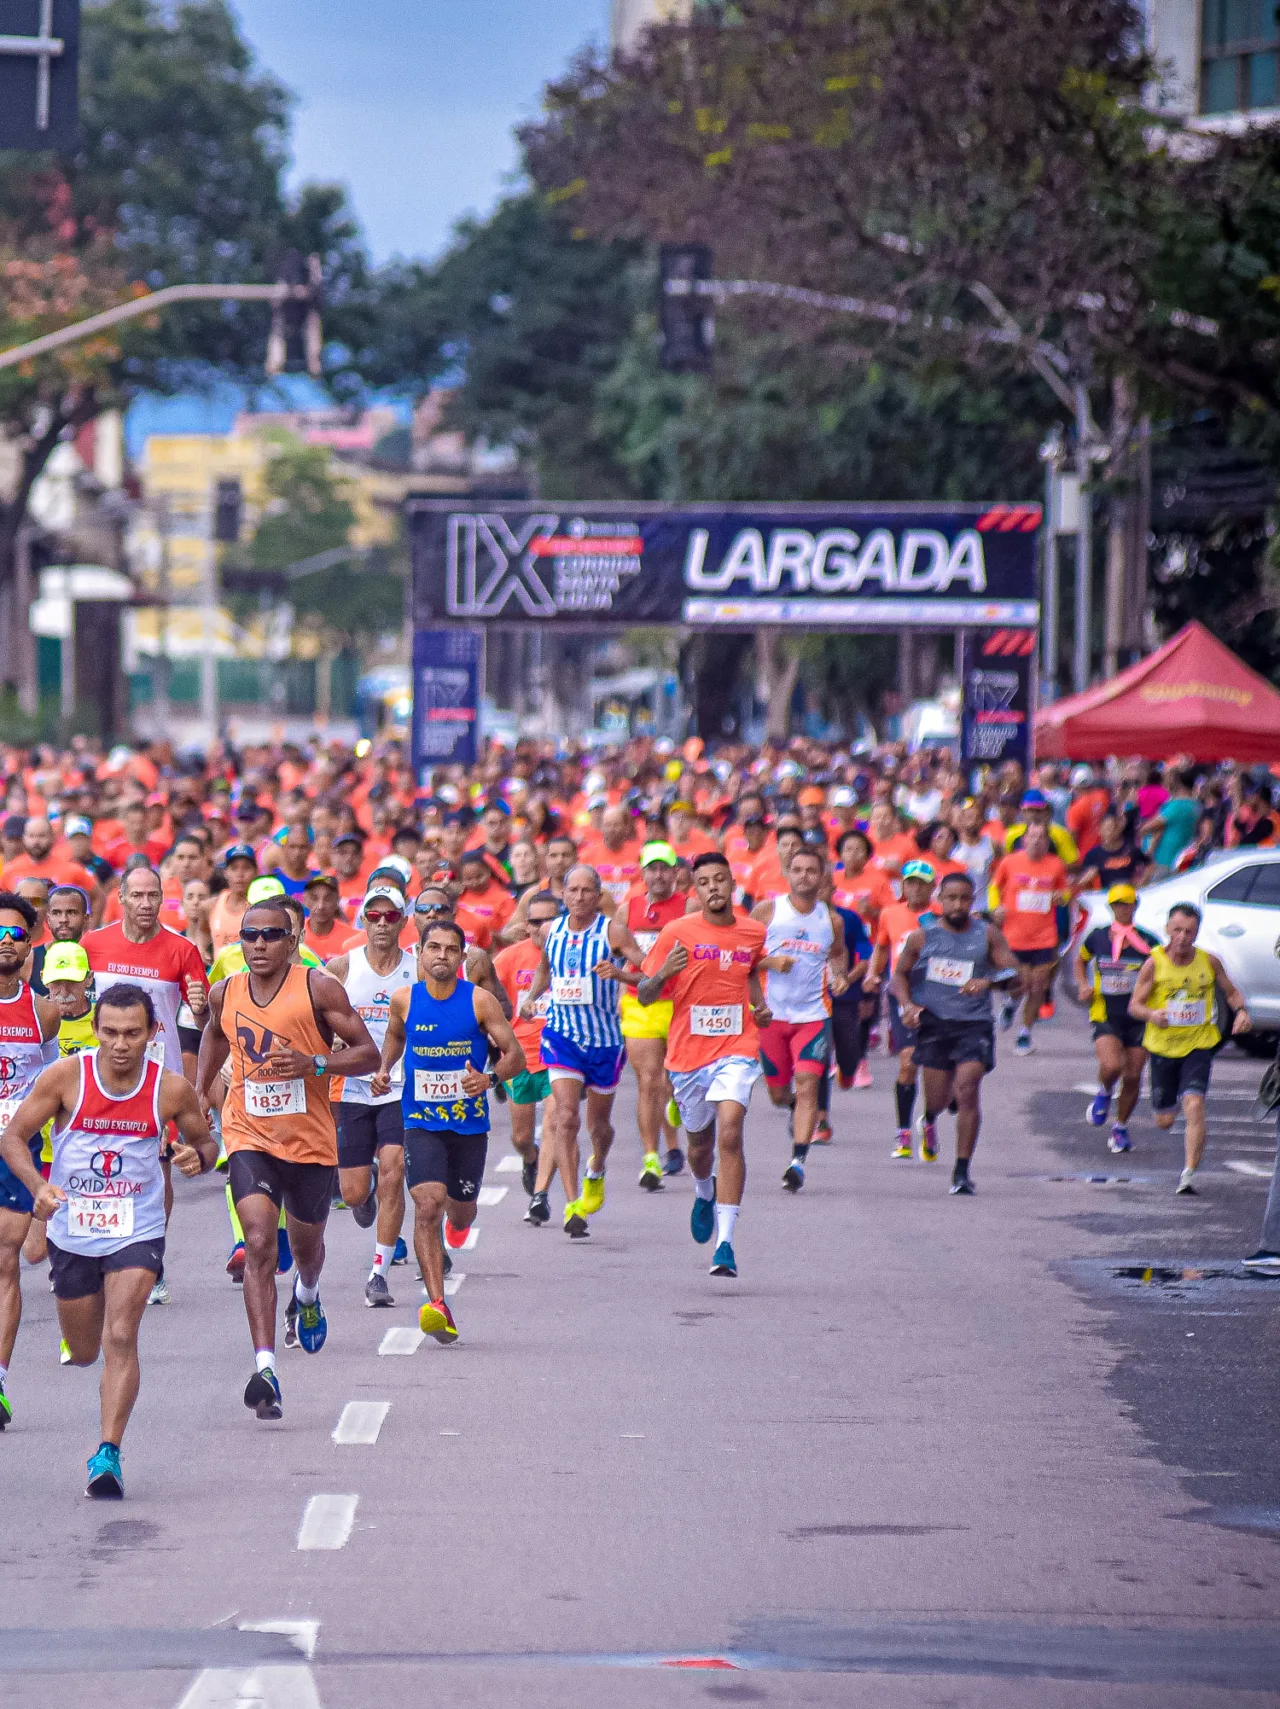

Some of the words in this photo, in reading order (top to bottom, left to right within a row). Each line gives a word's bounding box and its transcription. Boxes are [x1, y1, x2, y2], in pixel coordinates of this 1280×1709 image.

[446, 513, 560, 617] IX
[685, 527, 987, 592] LARGADA
[108, 963, 116, 972] EU
[117, 964, 129, 974] SOU
[130, 966, 159, 978] EXEMPLO
[698, 1017, 732, 1028] 1450
[2, 1027, 33, 1038] EXEMPLO
[435, 1074, 445, 1082] IX
[265, 1085, 276, 1094] IX
[422, 1083, 458, 1094] 1701
[251, 1093, 292, 1108] 1837
[83, 1118, 92, 1128] EU
[95, 1119, 109, 1130] SOU
[111, 1120, 148, 1132] EXEMPLO
[69, 1176, 142, 1195] OXIDATIVA
[92, 1200, 102, 1210] IX
[76, 1212, 119, 1227] 1734
